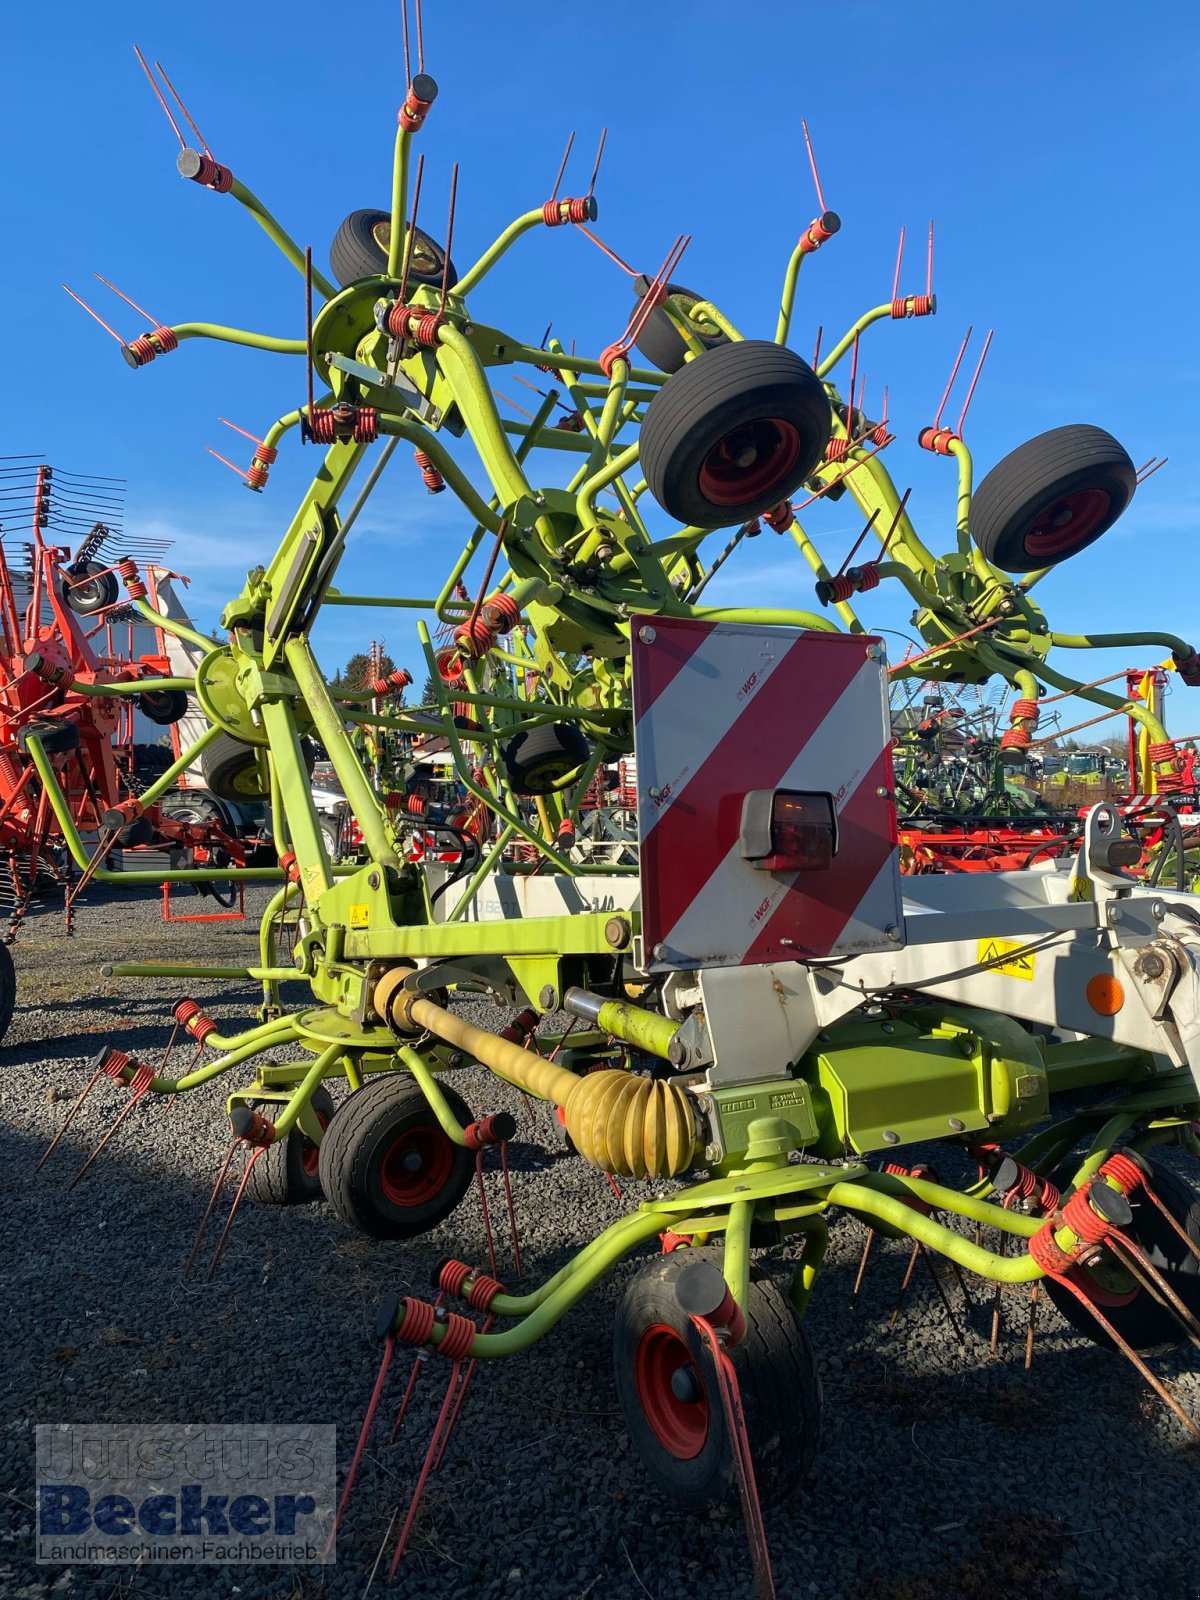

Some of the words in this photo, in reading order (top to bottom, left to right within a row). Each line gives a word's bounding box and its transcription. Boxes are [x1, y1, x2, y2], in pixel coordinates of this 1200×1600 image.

[741, 671, 757, 695] WGF
[654, 783, 671, 807] WGF
[753, 896, 770, 921] WGF
